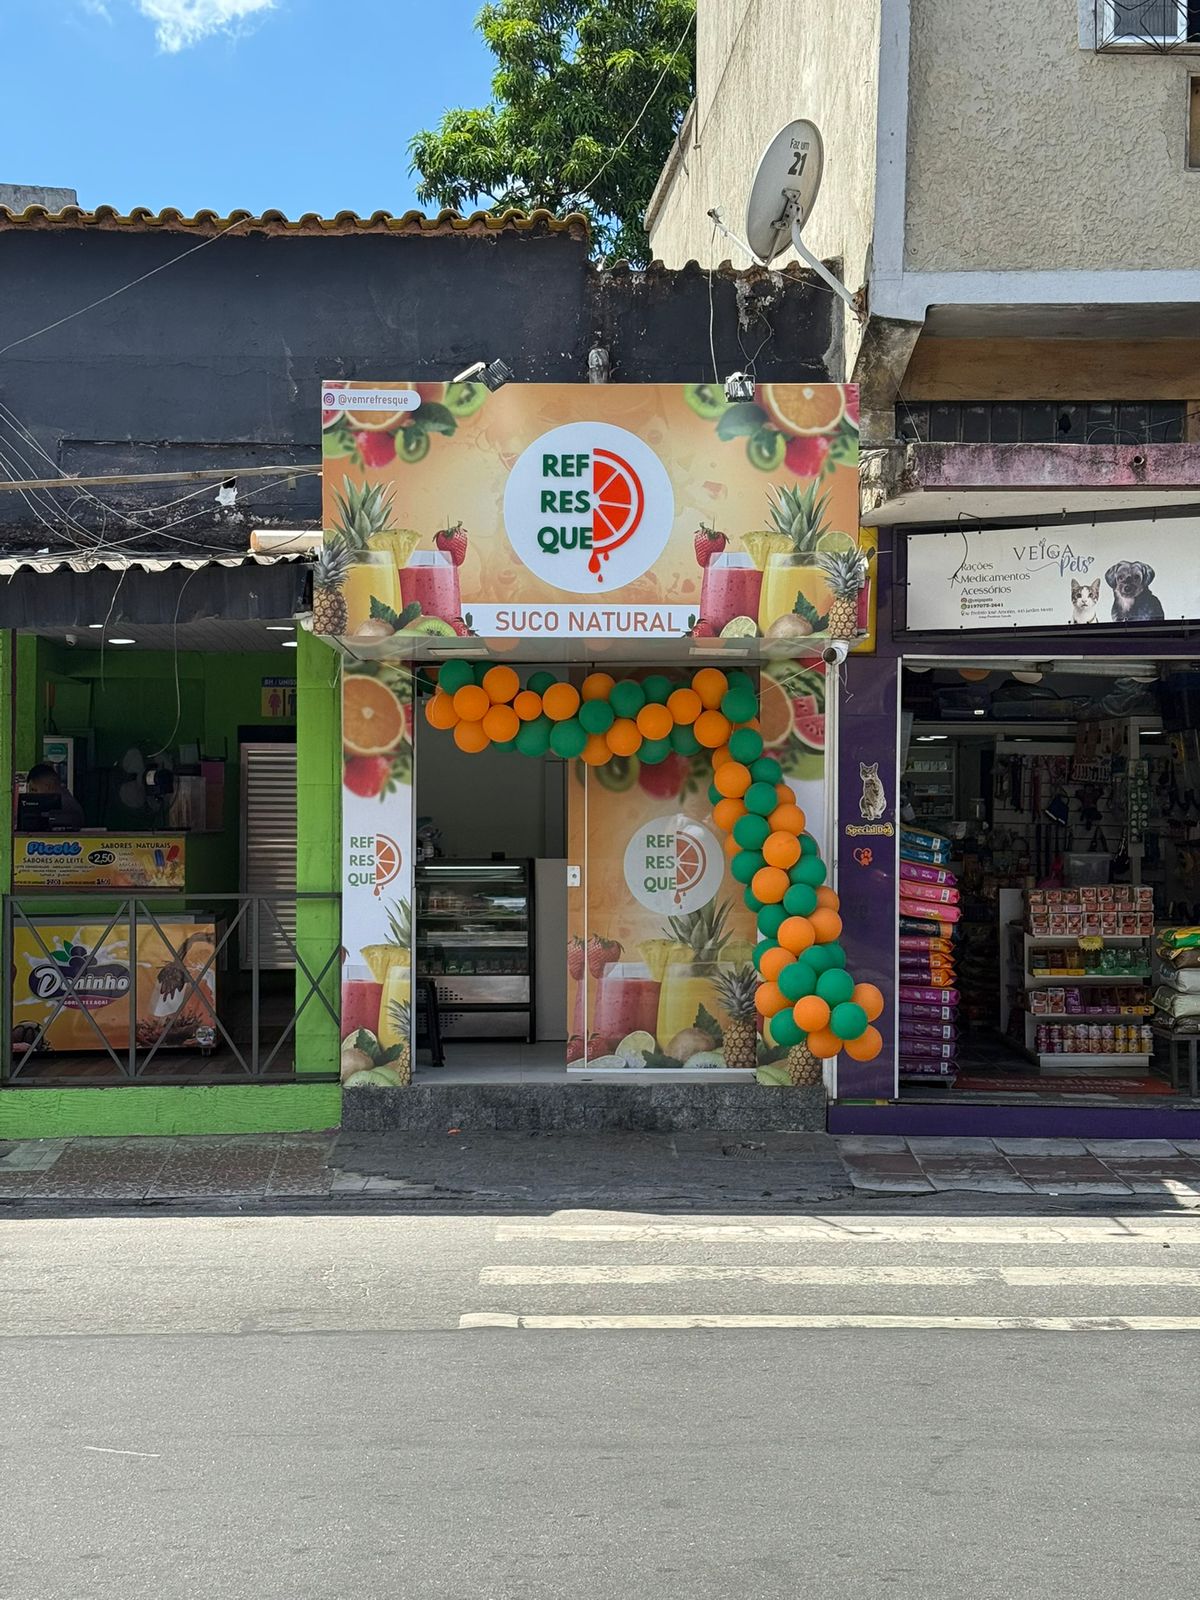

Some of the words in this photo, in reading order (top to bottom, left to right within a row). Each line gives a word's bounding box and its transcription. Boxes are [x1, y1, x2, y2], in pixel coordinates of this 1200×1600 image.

[790, 138, 800, 149] Faz
[801, 142, 810, 150] um
[788, 152, 807, 176] 21
[338, 394, 408, 406] @vemrefresque
[542, 454, 590, 477] REF
[540, 490, 591, 513] RES
[537, 526, 593, 554] QUE
[1013, 541, 1075, 560] VEIGA
[1060, 556, 1089, 577] Pets
[961, 572, 1030, 584] Medicamentos
[961, 585, 1012, 596] Acessórios
[495, 611, 559, 632] SUCO
[568, 611, 681, 632] NATURAL
[846, 825, 876, 835] Special
[350, 836, 374, 848] REF
[646, 835, 674, 848] REF
[27, 842, 82, 855] Picolé
[94, 853, 113, 863] 2,50
[349, 855, 375, 866] RES
[645, 856, 675, 869] RES
[348, 873, 376, 887] QUE
[643, 877, 677, 893] QUE
